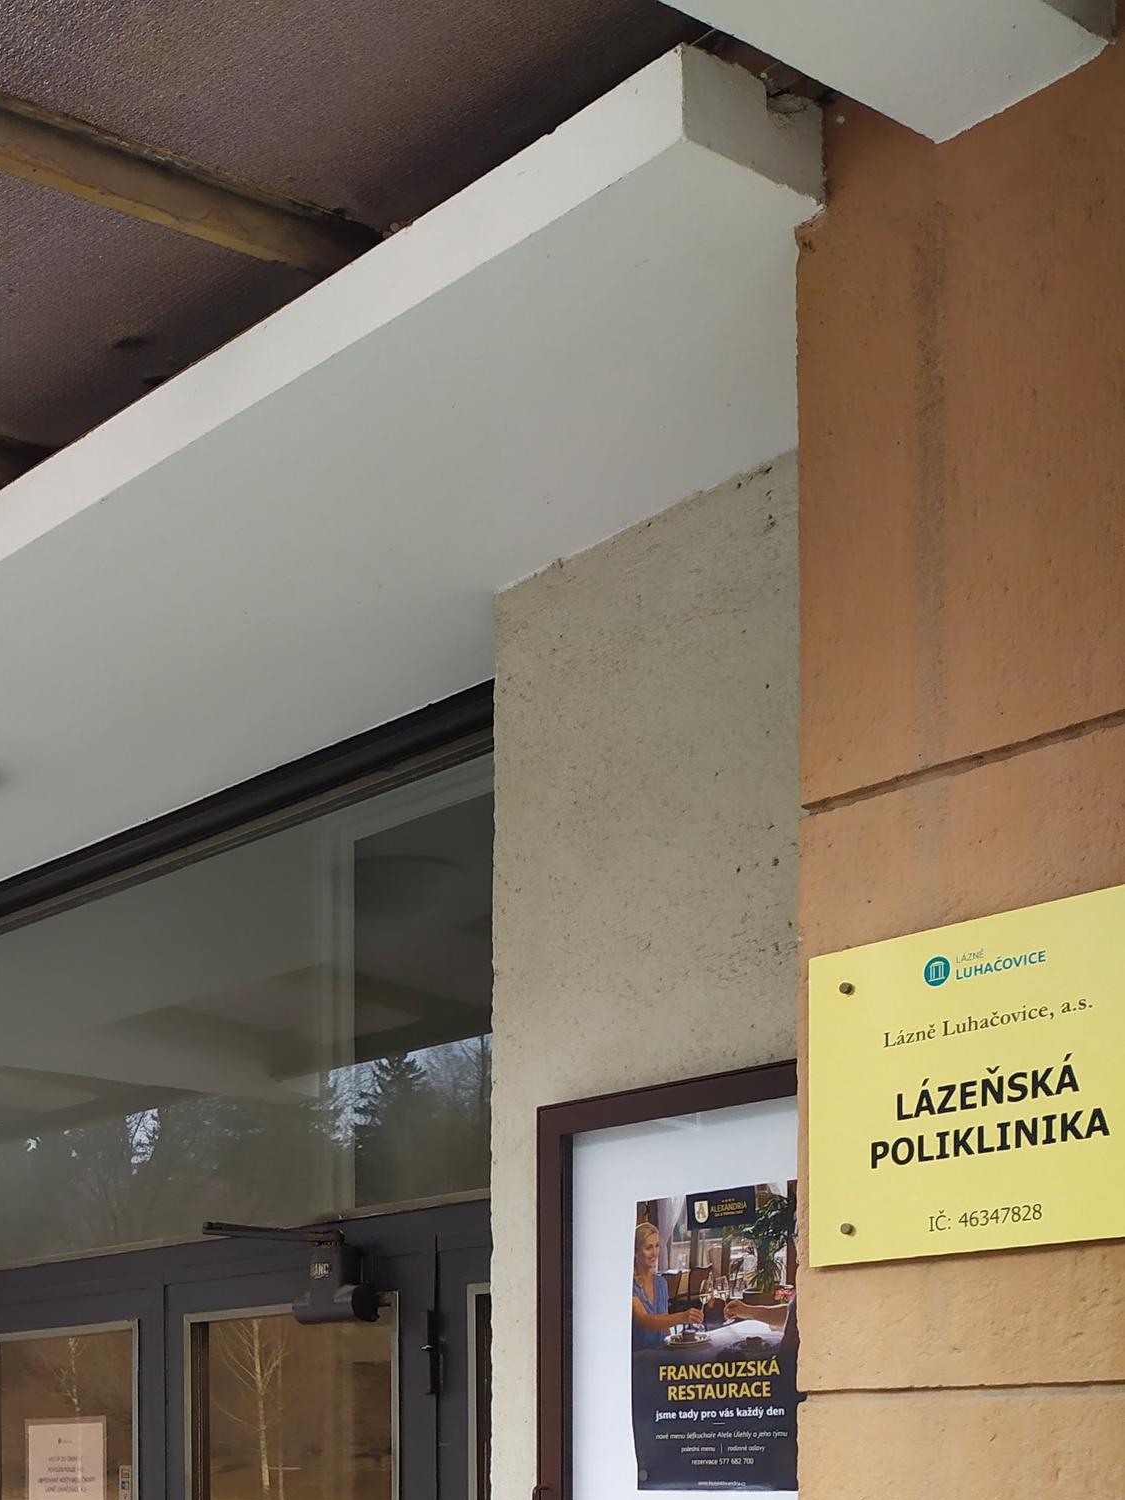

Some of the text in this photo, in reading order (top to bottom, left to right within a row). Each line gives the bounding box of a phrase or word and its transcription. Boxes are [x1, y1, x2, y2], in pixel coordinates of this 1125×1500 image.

[955, 950, 1047, 981] LUHAČOVICE
[883, 998, 1094, 1049] Lázně Luhačovice, a.s.
[896, 1053, 1080, 1121] LÁZEŇSKÁ
[870, 1107, 1111, 1169] POLIKLINIKA
[928, 1203, 1043, 1233] IČ: 46347828
[659, 1355, 780, 1381] FRANCOUZSKÁ
[668, 1381, 772, 1401] RESTAURACE
[655, 1406, 785, 1422] jsme tady pro vás každý den
